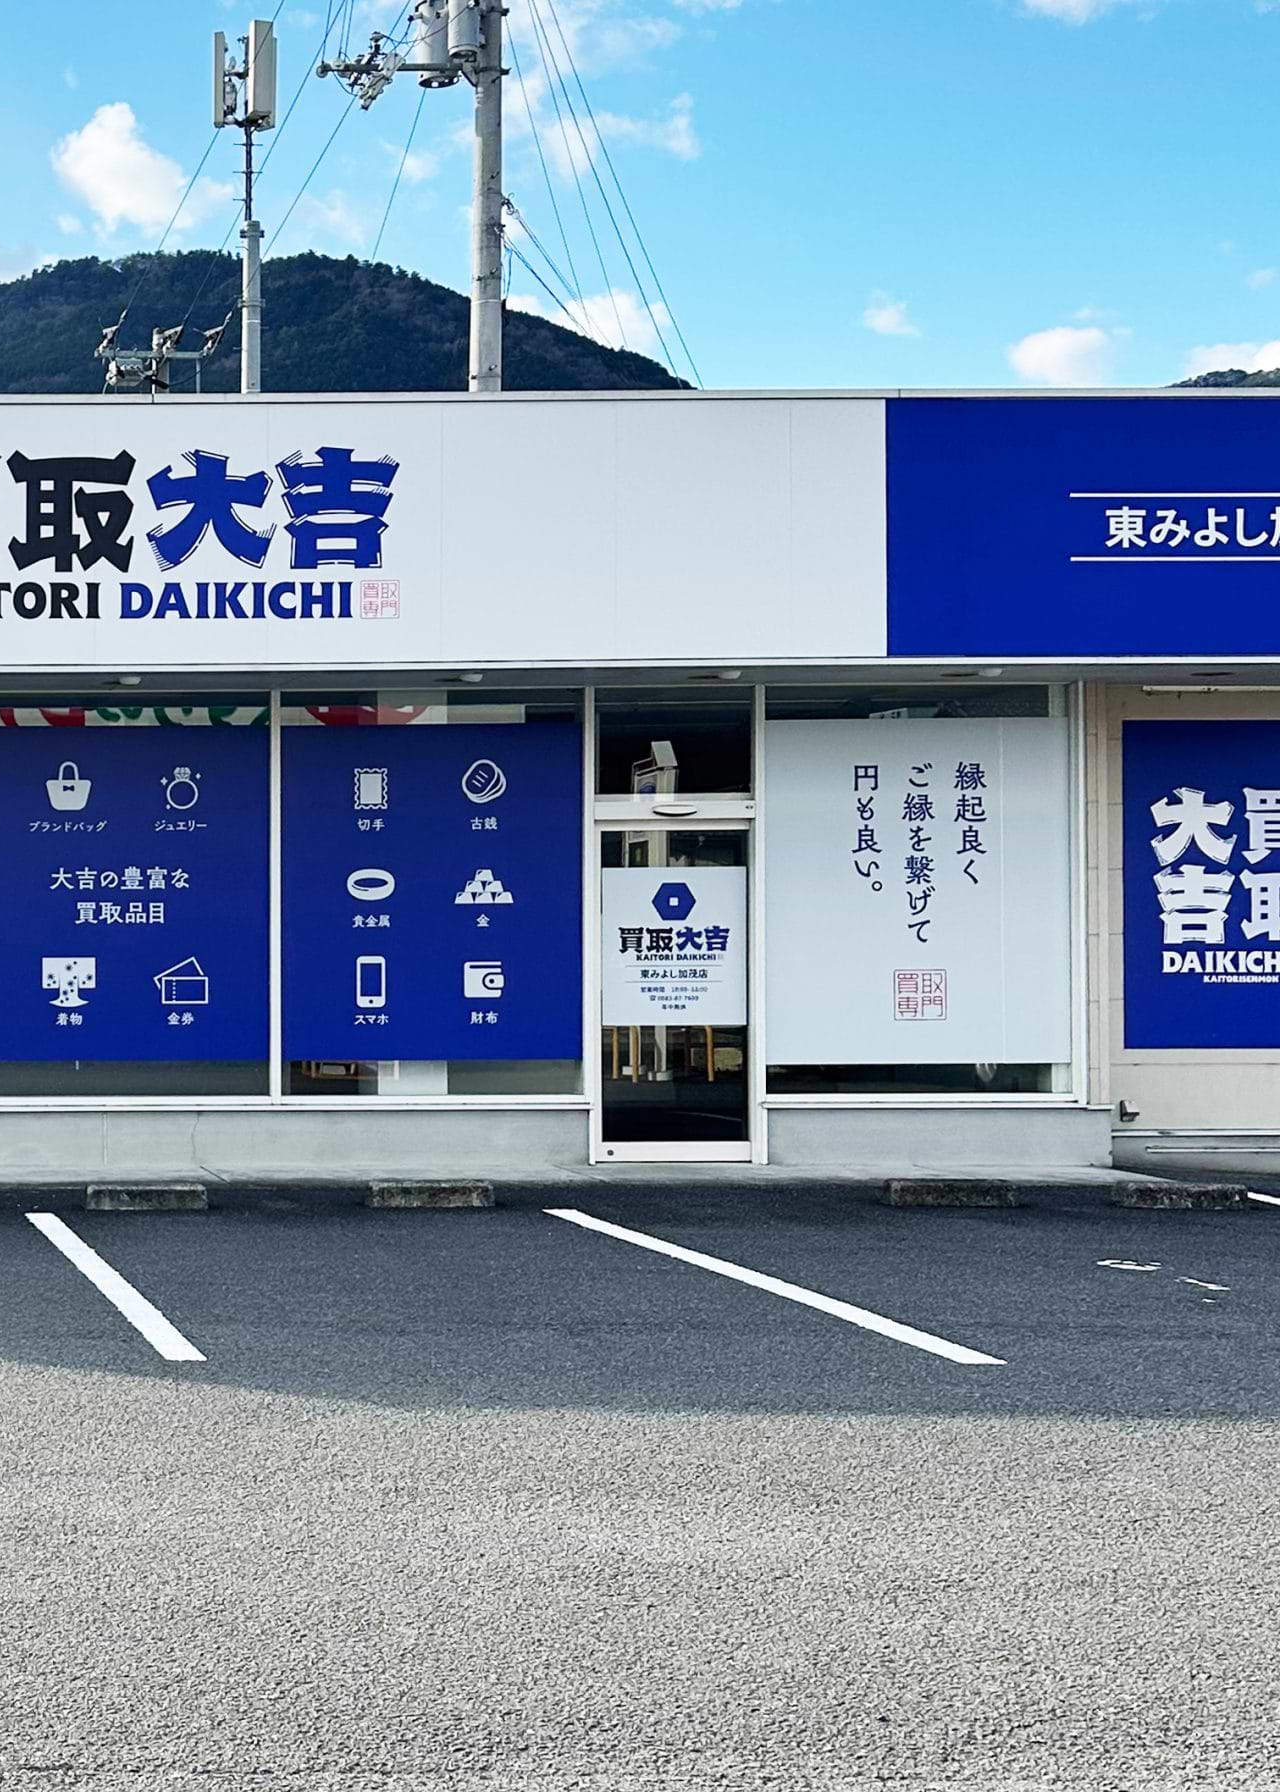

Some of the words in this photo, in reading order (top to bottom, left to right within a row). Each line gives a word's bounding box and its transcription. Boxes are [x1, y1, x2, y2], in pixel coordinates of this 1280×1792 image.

[1105, 506, 1280, 548] 東みよし
[119, 581, 353, 620] DAIKICHI
[29, 820, 108, 833] ブランドバッグ
[154, 819, 207, 832] ジュエリー
[357, 818, 385, 832] 切手
[470, 816, 498, 830] 古銭
[851, 764, 884, 893] 円も良い。
[953, 761, 988, 885] 縁起良く
[901, 762, 936, 943] ご縁を繋げて
[1150, 786, 1238, 945] 大吉
[49, 866, 191, 890] 大吉の豊富な
[75, 901, 166, 925] 買取品目
[476, 913, 490, 927] 金
[352, 914, 391, 928] 貴金属
[617, 925, 730, 954] 買取大吉
[640, 968, 708, 979] 東みよし加茂店
[55, 1012, 83, 1026] 着物
[167, 1011, 194, 1026] 金券
[354, 1012, 389, 1026] スマホ
[470, 1010, 499, 1025] 財布
